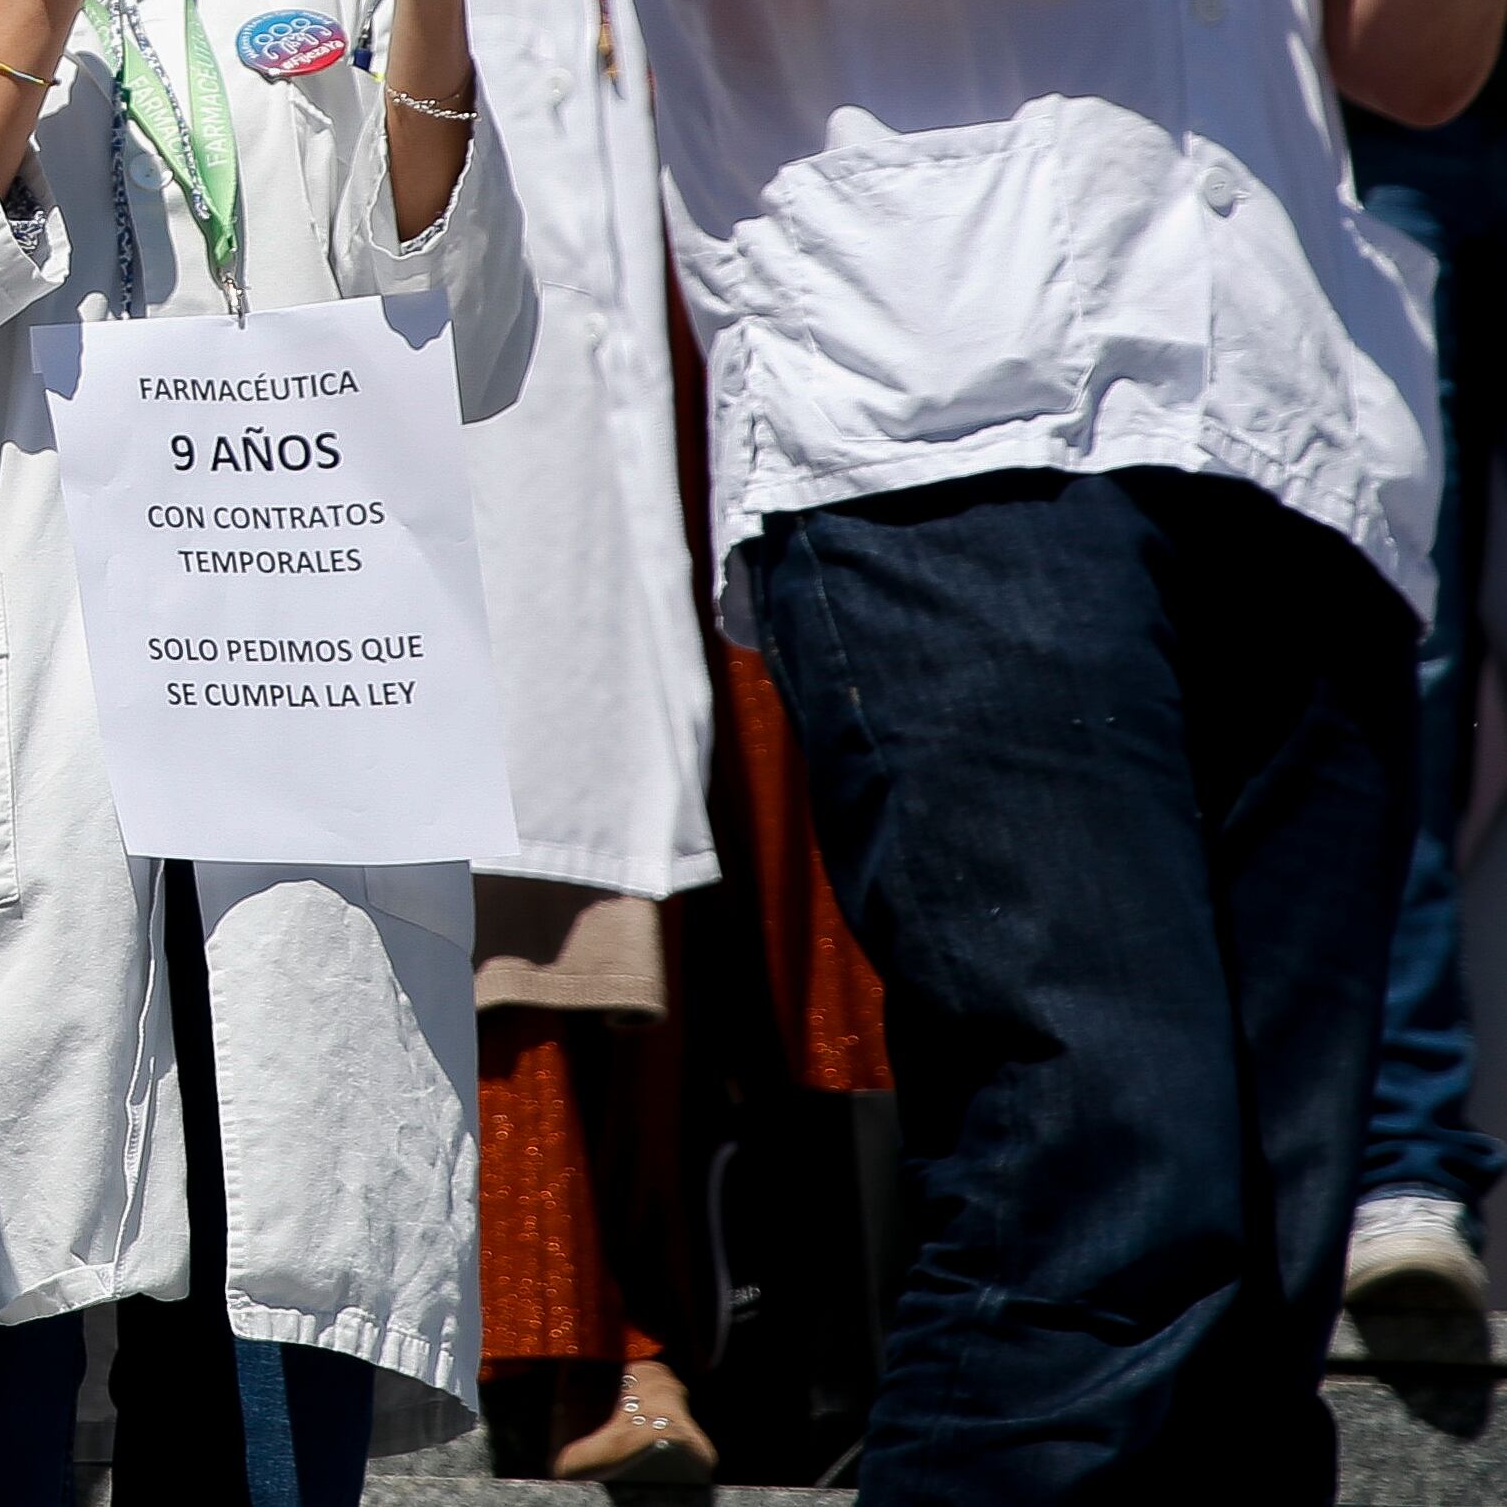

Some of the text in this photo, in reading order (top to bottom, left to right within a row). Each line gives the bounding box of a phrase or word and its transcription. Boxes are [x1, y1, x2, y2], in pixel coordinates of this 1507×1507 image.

[139, 371, 359, 402] FARMACÉUTICA
[171, 426, 340, 472] 9 AÑOS
[148, 501, 384, 529] CON CONTRATOS
[178, 548, 362, 574] TEMPORALES
[148, 635, 424, 663] SOLO PEDIMOS QUE
[167, 681, 415, 708] SE CUMPLA LA LEY
